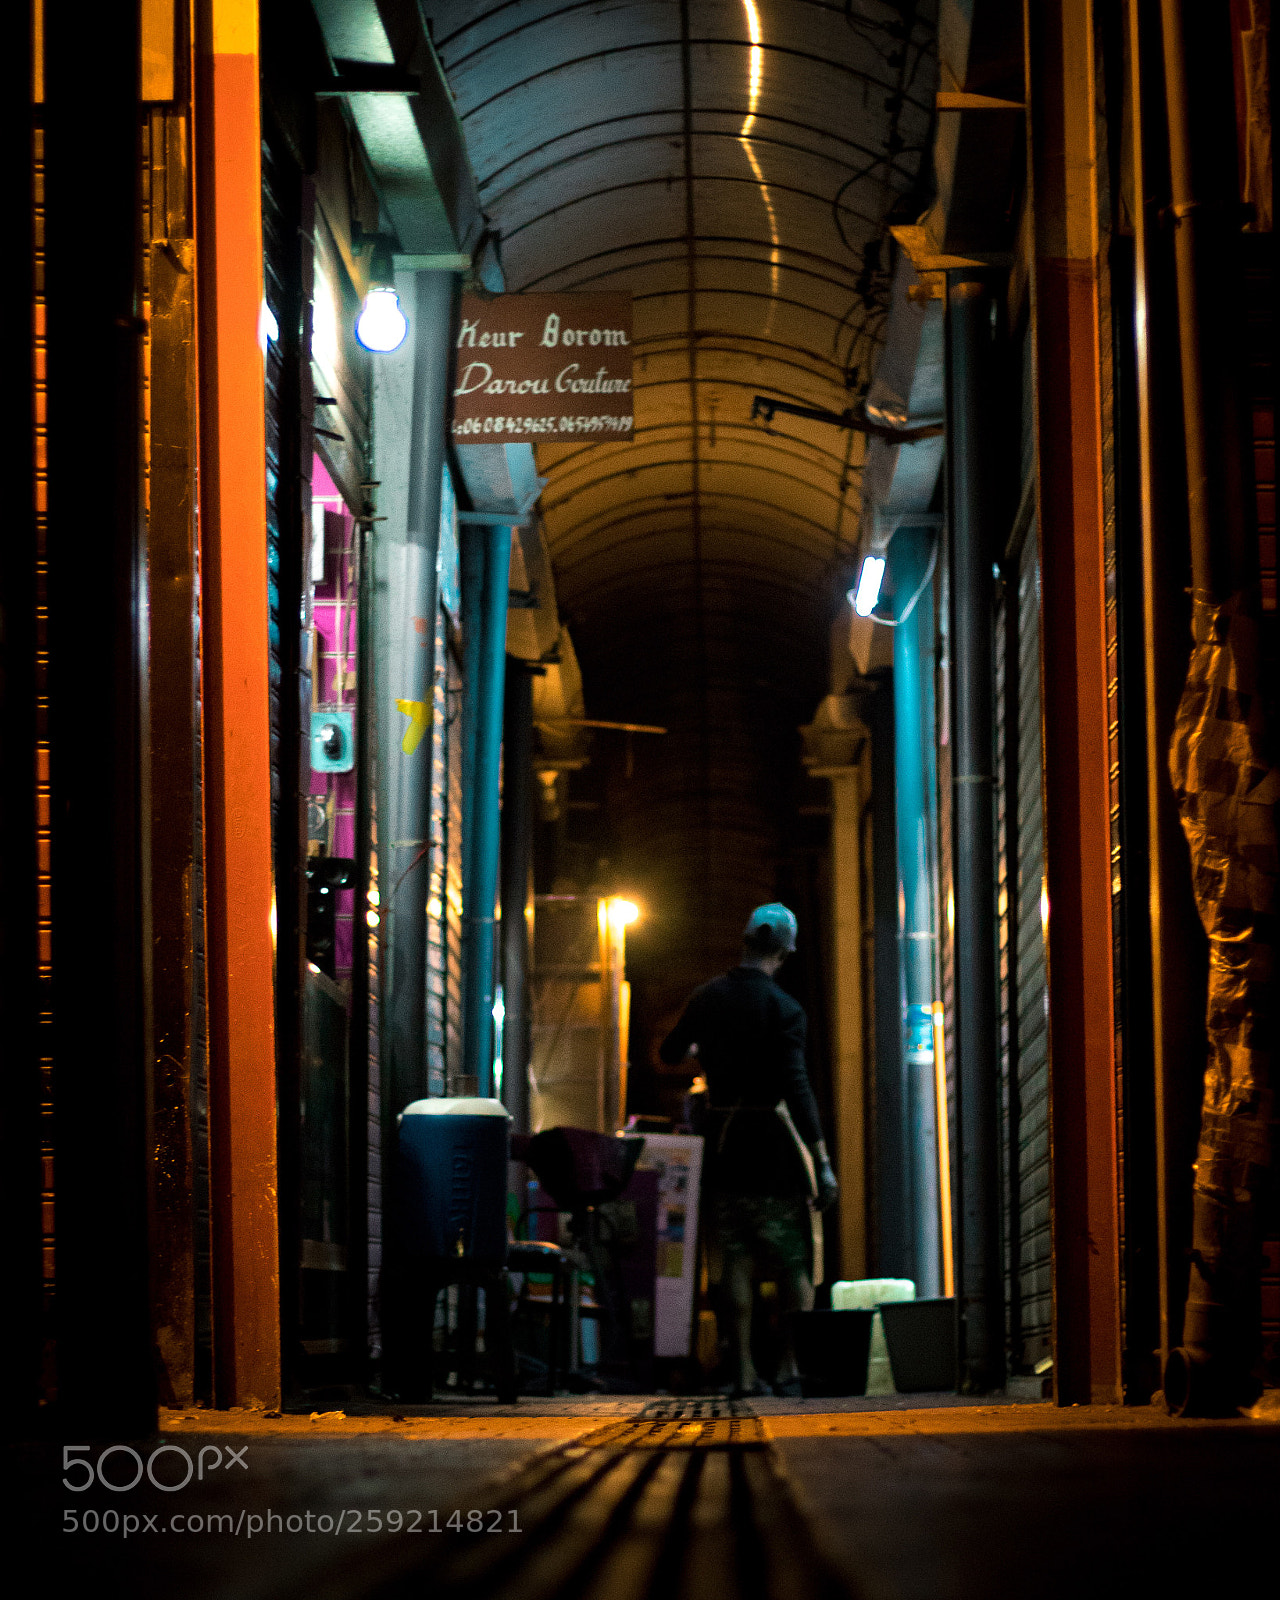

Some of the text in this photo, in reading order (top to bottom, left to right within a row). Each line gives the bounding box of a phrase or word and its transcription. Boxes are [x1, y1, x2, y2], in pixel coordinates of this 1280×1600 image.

[457, 312, 631, 348] Keur Borom
[454, 361, 633, 397] Darou Couture
